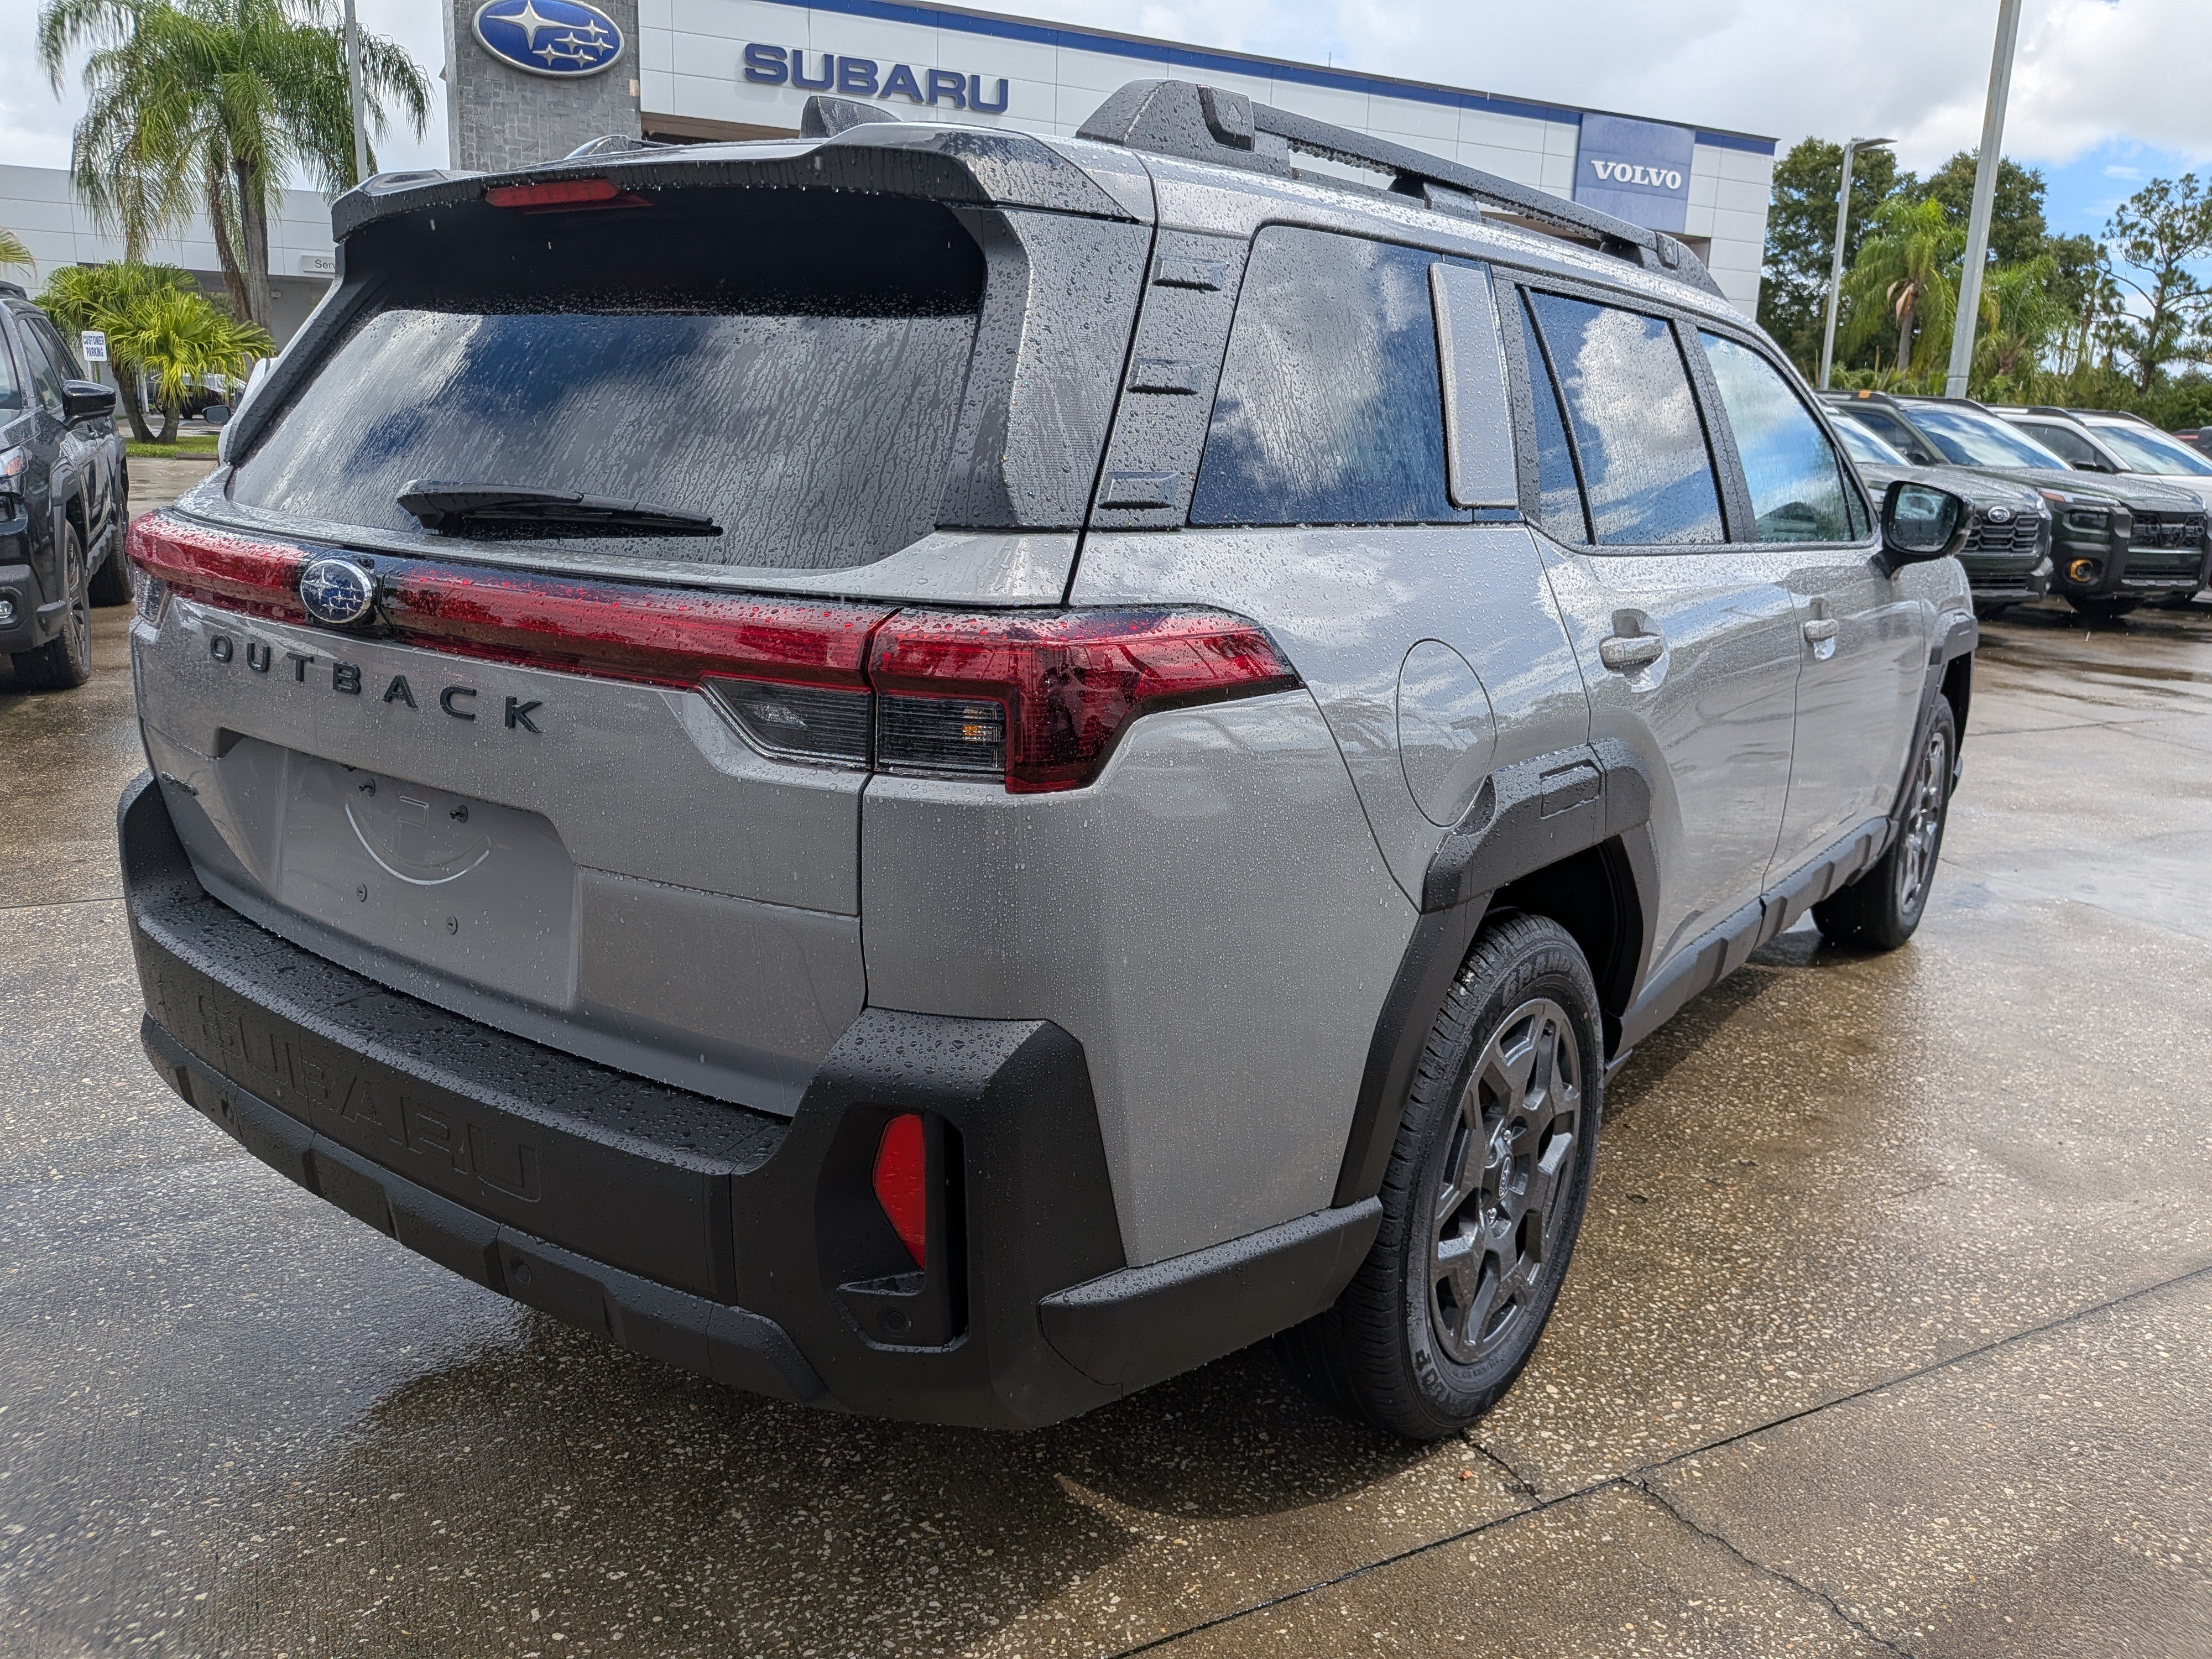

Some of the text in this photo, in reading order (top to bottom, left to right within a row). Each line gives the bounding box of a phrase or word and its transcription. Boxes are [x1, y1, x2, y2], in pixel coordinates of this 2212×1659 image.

[744, 43, 1009, 114] SUBARU
[1590, 159, 1682, 190] VOLVO
[83, 335, 105, 345] CUSTOMER
[86, 347, 104, 357] PARKING
[210, 633, 544, 733] OUTBACK
[197, 993, 542, 1203] SUBARU
